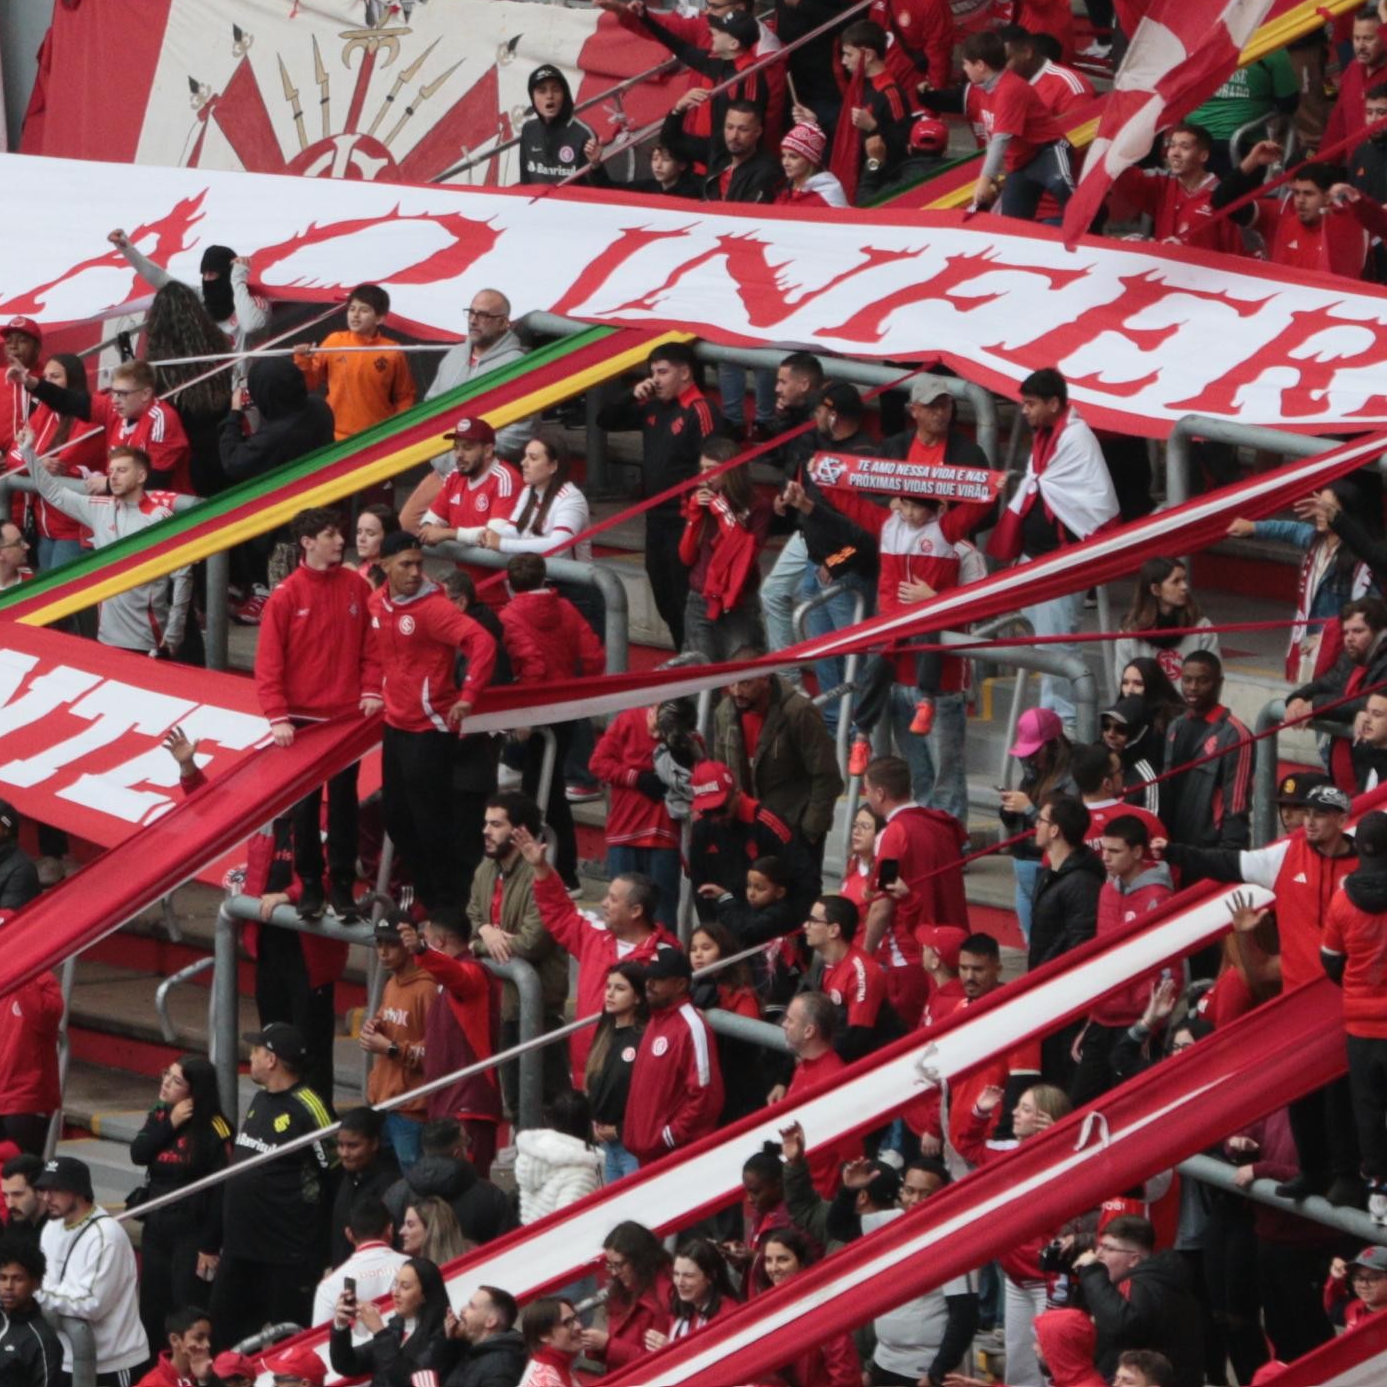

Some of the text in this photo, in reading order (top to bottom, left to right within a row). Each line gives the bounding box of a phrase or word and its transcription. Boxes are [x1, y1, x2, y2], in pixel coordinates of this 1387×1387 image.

[858, 459, 989, 483] TE AMO NESSA VIDA E NAS
[902, 478, 934, 494] VIDAS
[934, 481, 956, 496] QUE
